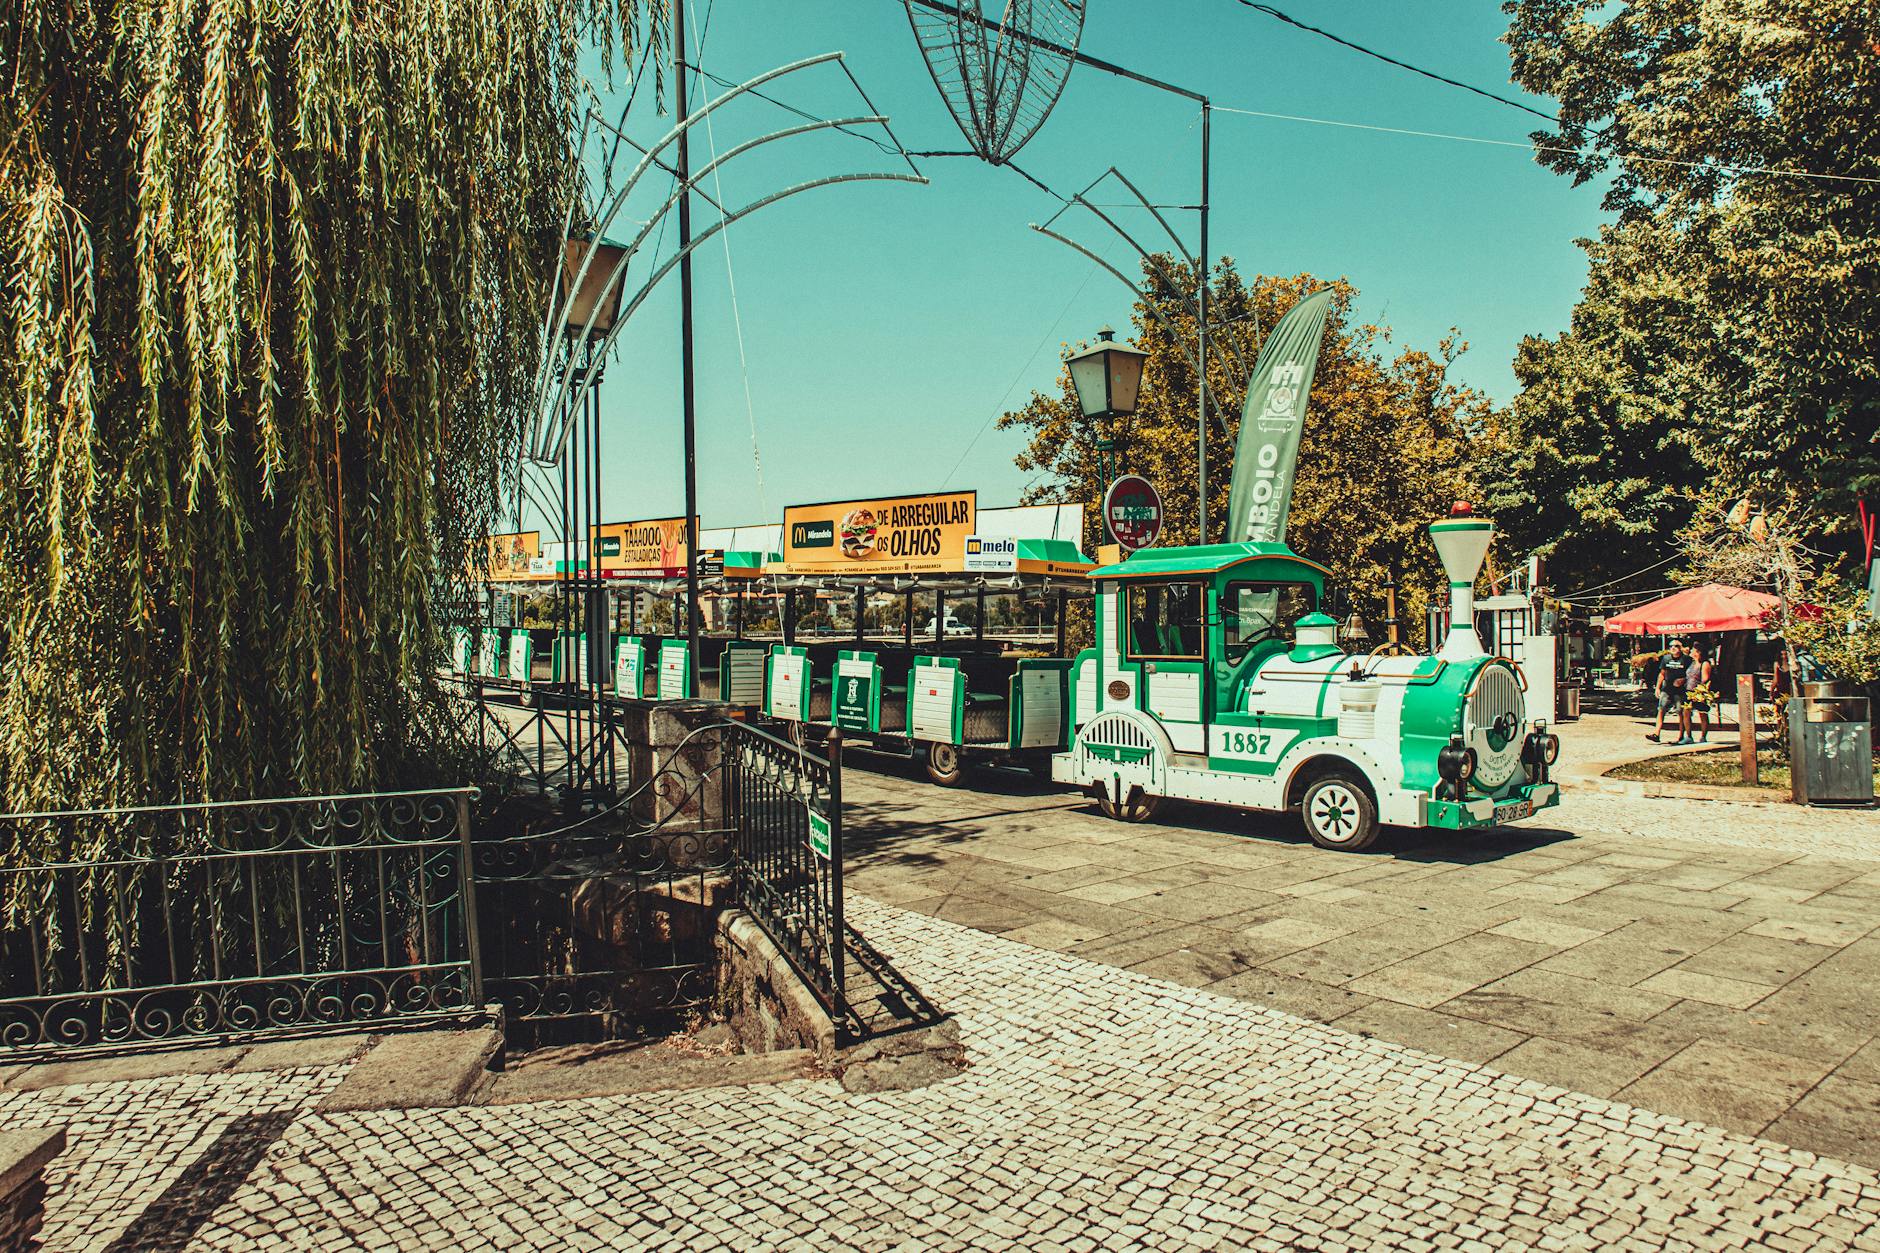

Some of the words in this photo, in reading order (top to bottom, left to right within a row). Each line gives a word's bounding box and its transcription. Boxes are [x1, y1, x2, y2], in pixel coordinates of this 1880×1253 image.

[877, 509, 889, 526] DE
[891, 500, 969, 528] ARREGUILAR
[877, 536, 889, 552] OS
[890, 527, 942, 557] OLHOS
[983, 540, 1015, 553] melo
[1221, 731, 1271, 755] 1887
